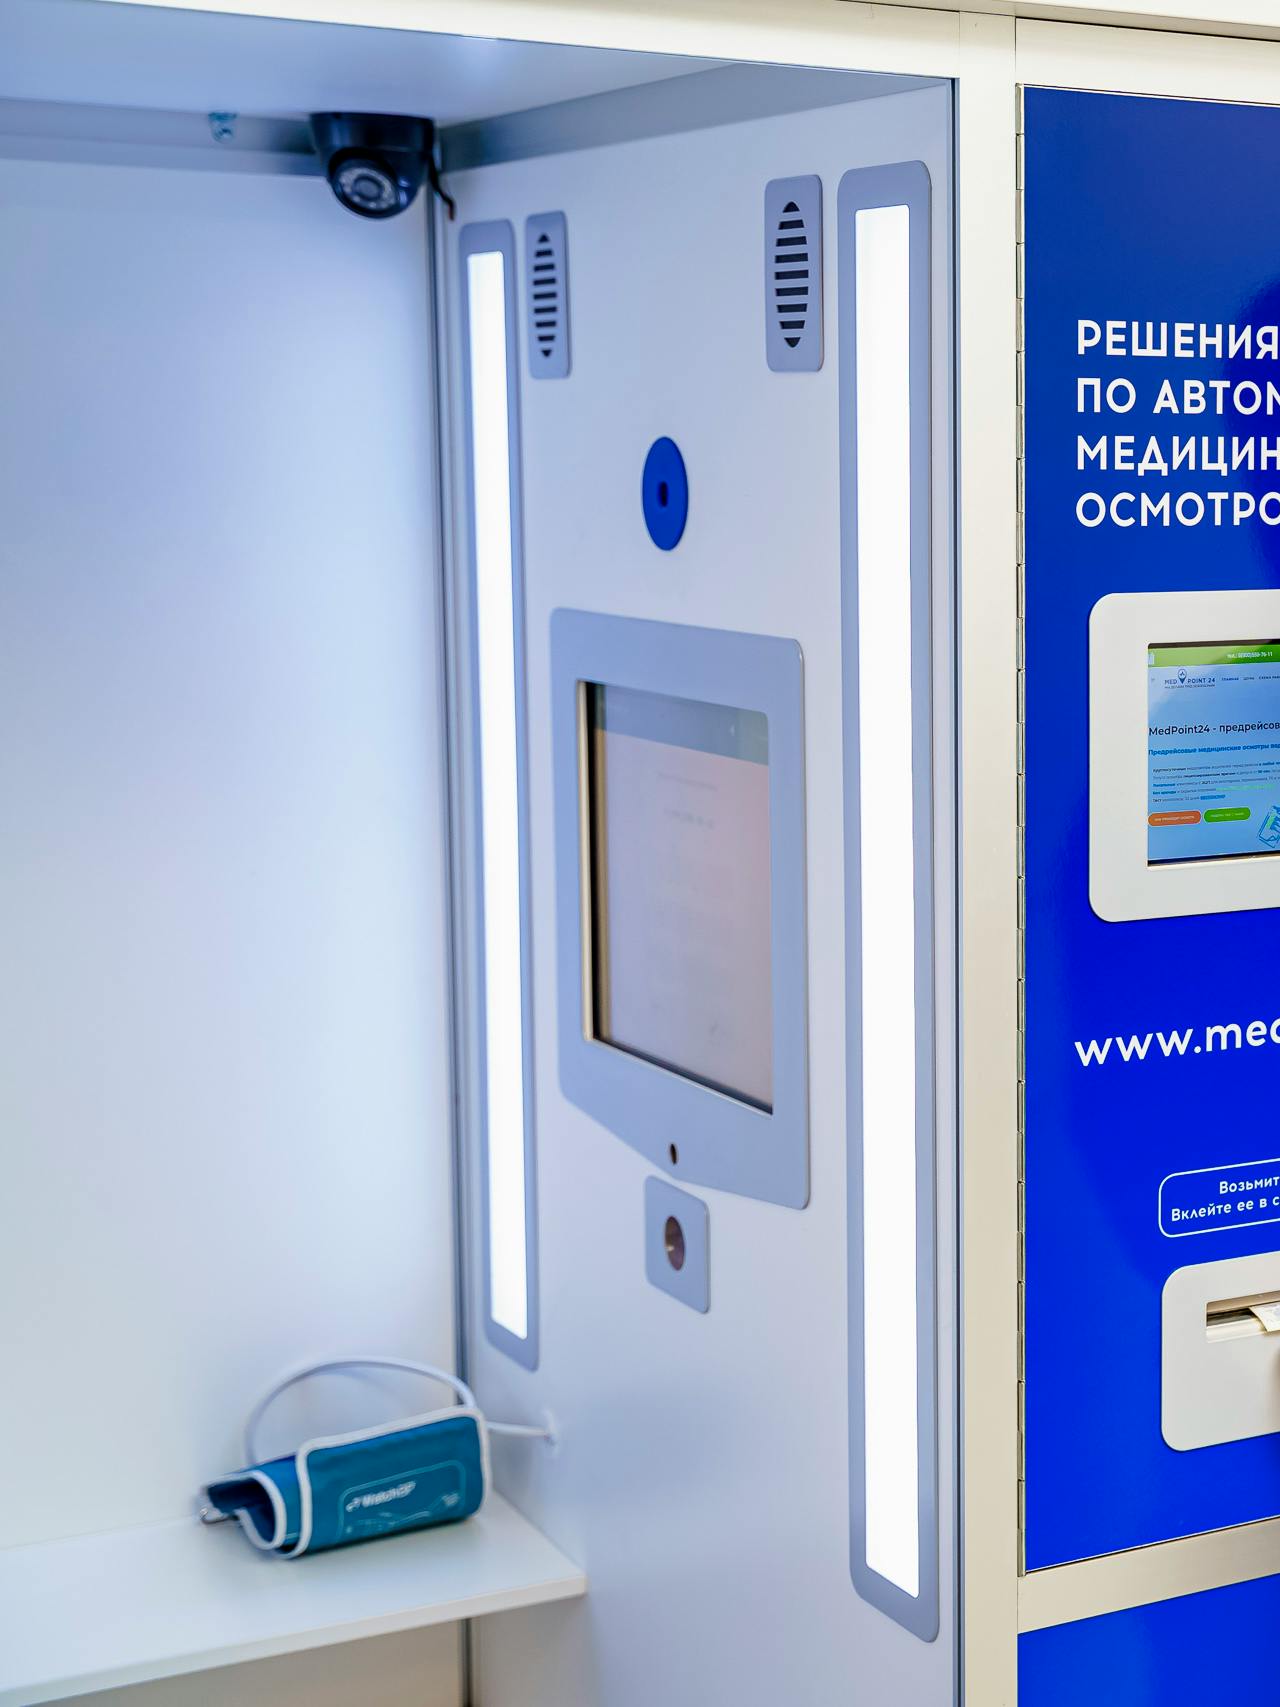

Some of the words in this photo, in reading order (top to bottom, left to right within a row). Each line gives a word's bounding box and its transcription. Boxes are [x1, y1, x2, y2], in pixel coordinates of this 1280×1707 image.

[1077, 320, 1279, 359] РЕШЕНИЯ
[1077, 378, 1136, 413] ПО
[1148, 724, 1210, 736] MedPoint24
[1171, 1202, 1232, 1222] Вклейте
[1236, 1200, 1254, 1212] ее
[1259, 1198, 1268, 1209] в
